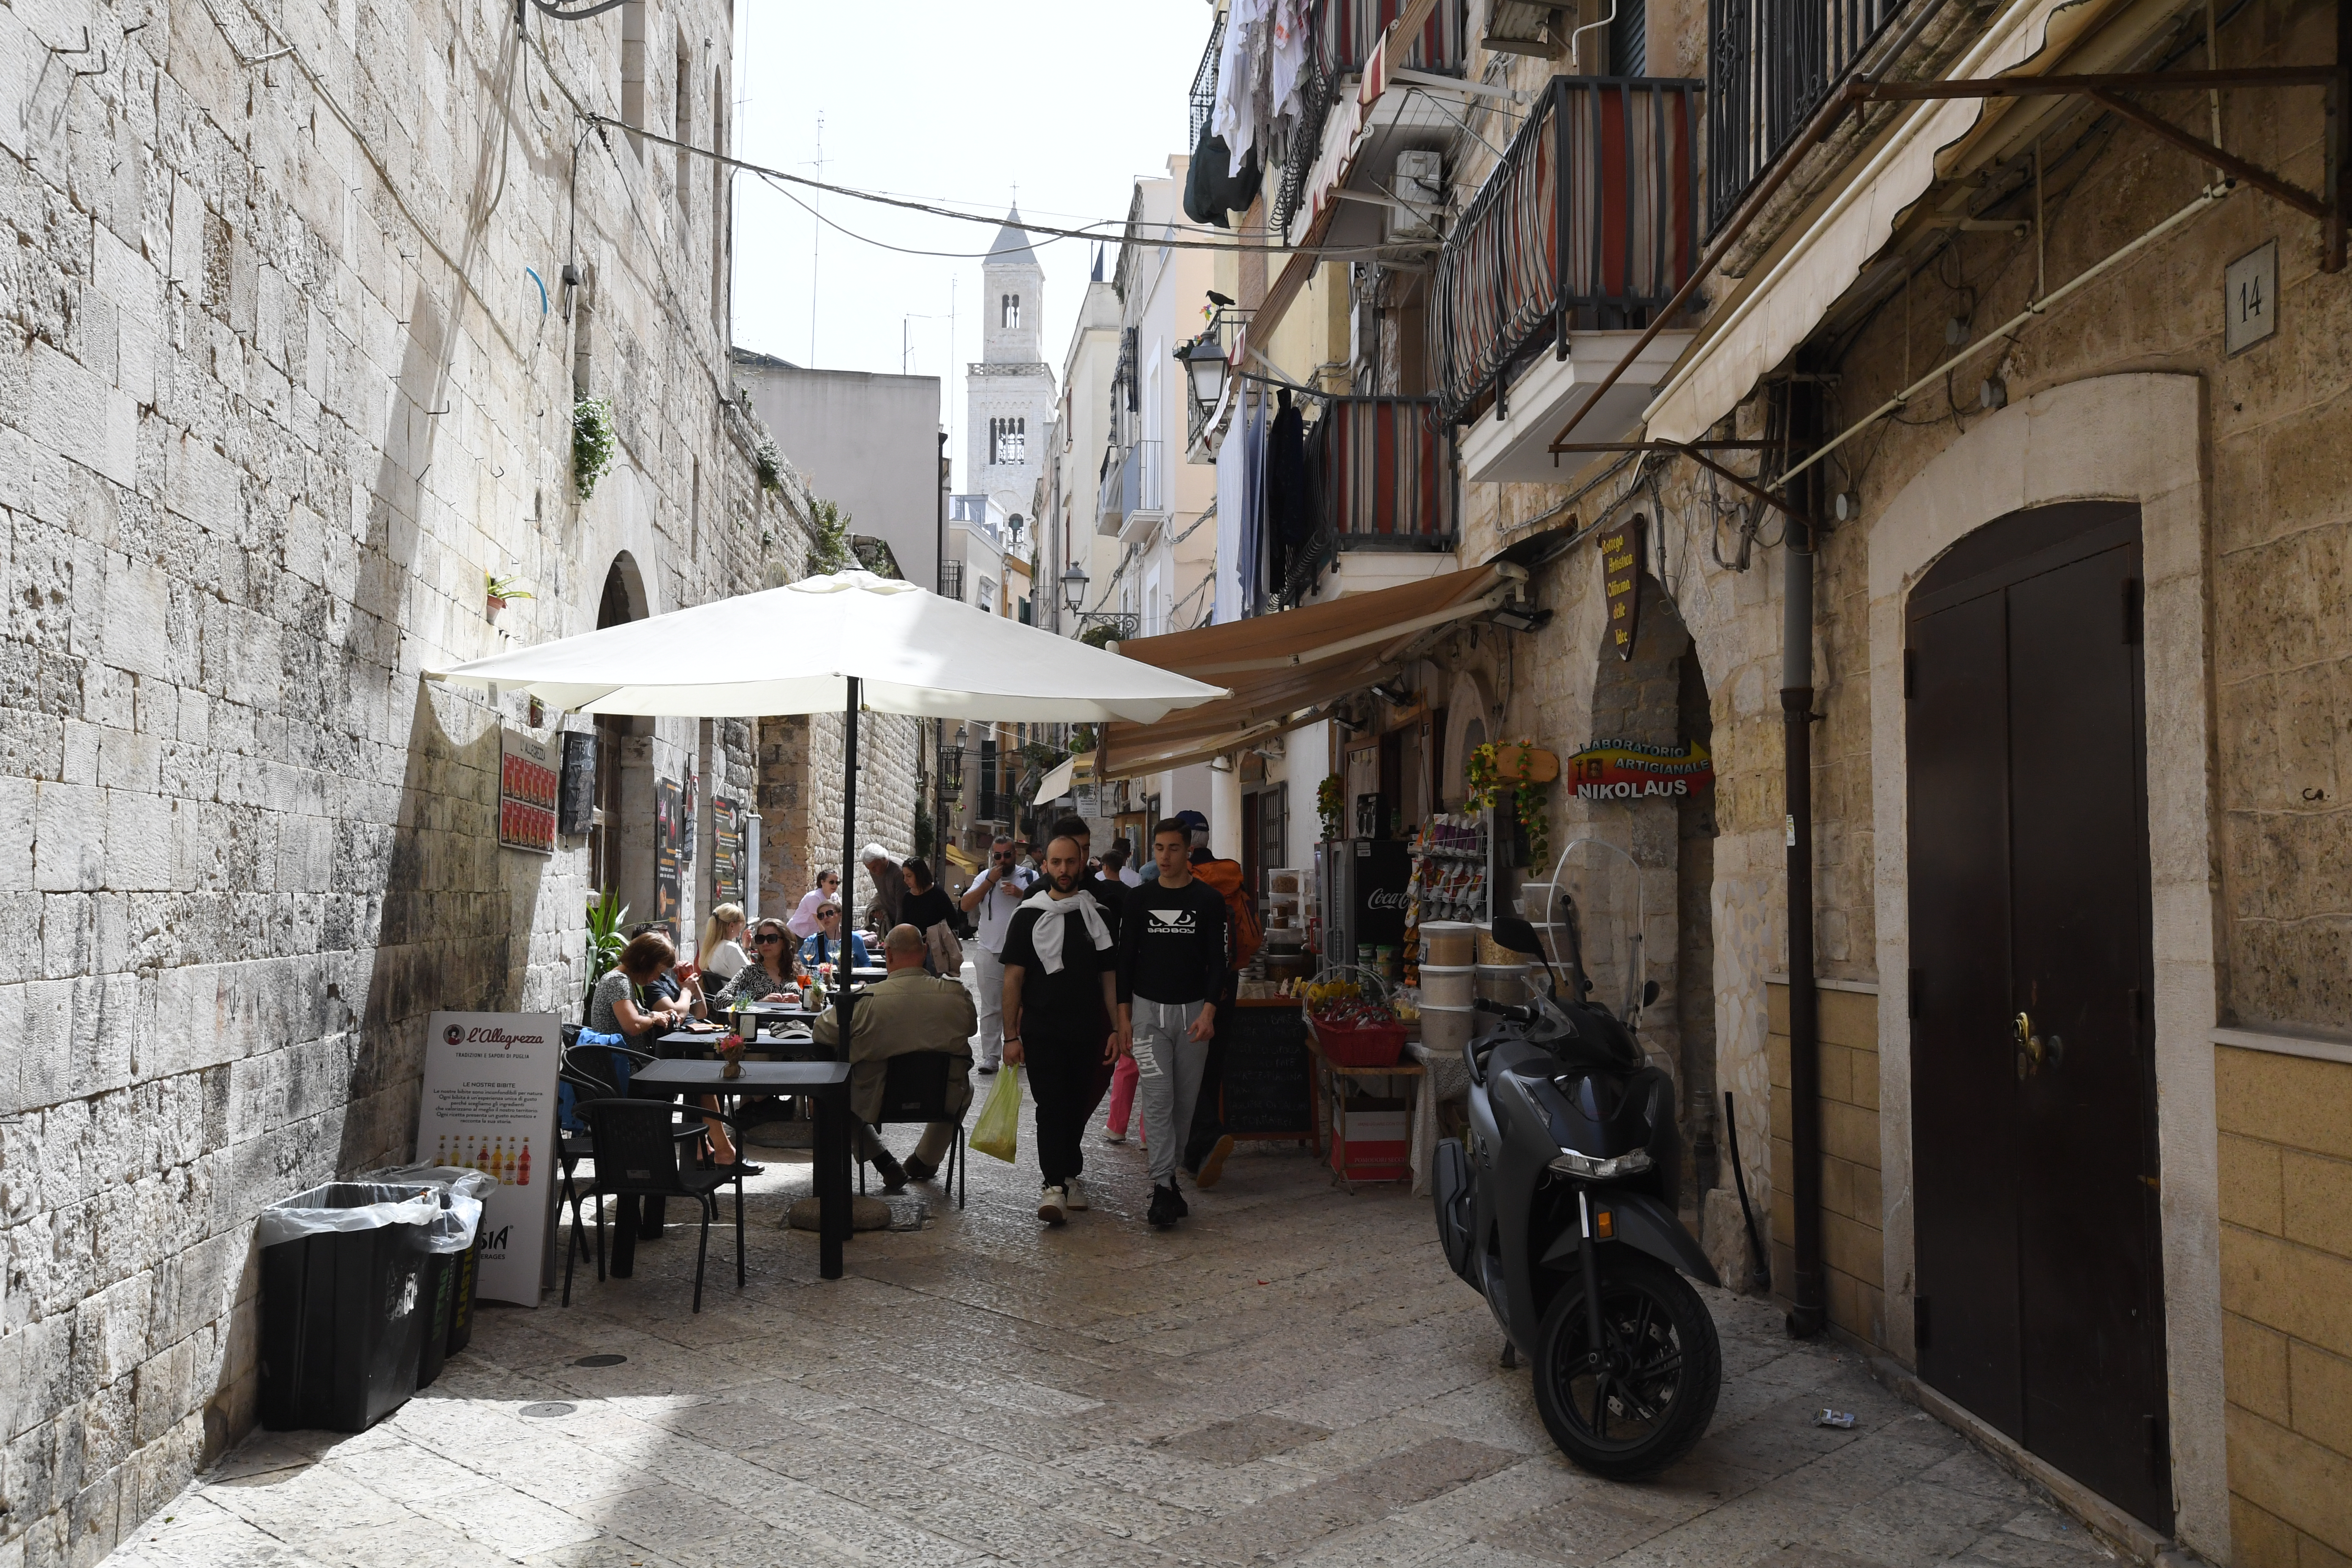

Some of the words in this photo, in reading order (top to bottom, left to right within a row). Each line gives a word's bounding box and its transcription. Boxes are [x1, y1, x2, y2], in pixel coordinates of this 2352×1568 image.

[2238, 275, 2262, 323] 14
[1601, 534, 1625, 555] Bottega
[1609, 552, 1634, 574] Artistica
[1607, 579, 1631, 598] Officina
[1613, 602, 1626, 620] delle
[1580, 739, 1684, 758] LABORATORIO
[1615, 758, 1710, 775] ARTIGIANALE
[1577, 779, 1687, 799] NIKOLAUS
[1368, 888, 1410, 909] Coca-C
[467, 1027, 544, 1049] l'Allegrezza
[1132, 1034, 1164, 1078] LEONE
[481, 1225, 509, 1250] SIA
[456, 1241, 475, 1328] PLASTIC
